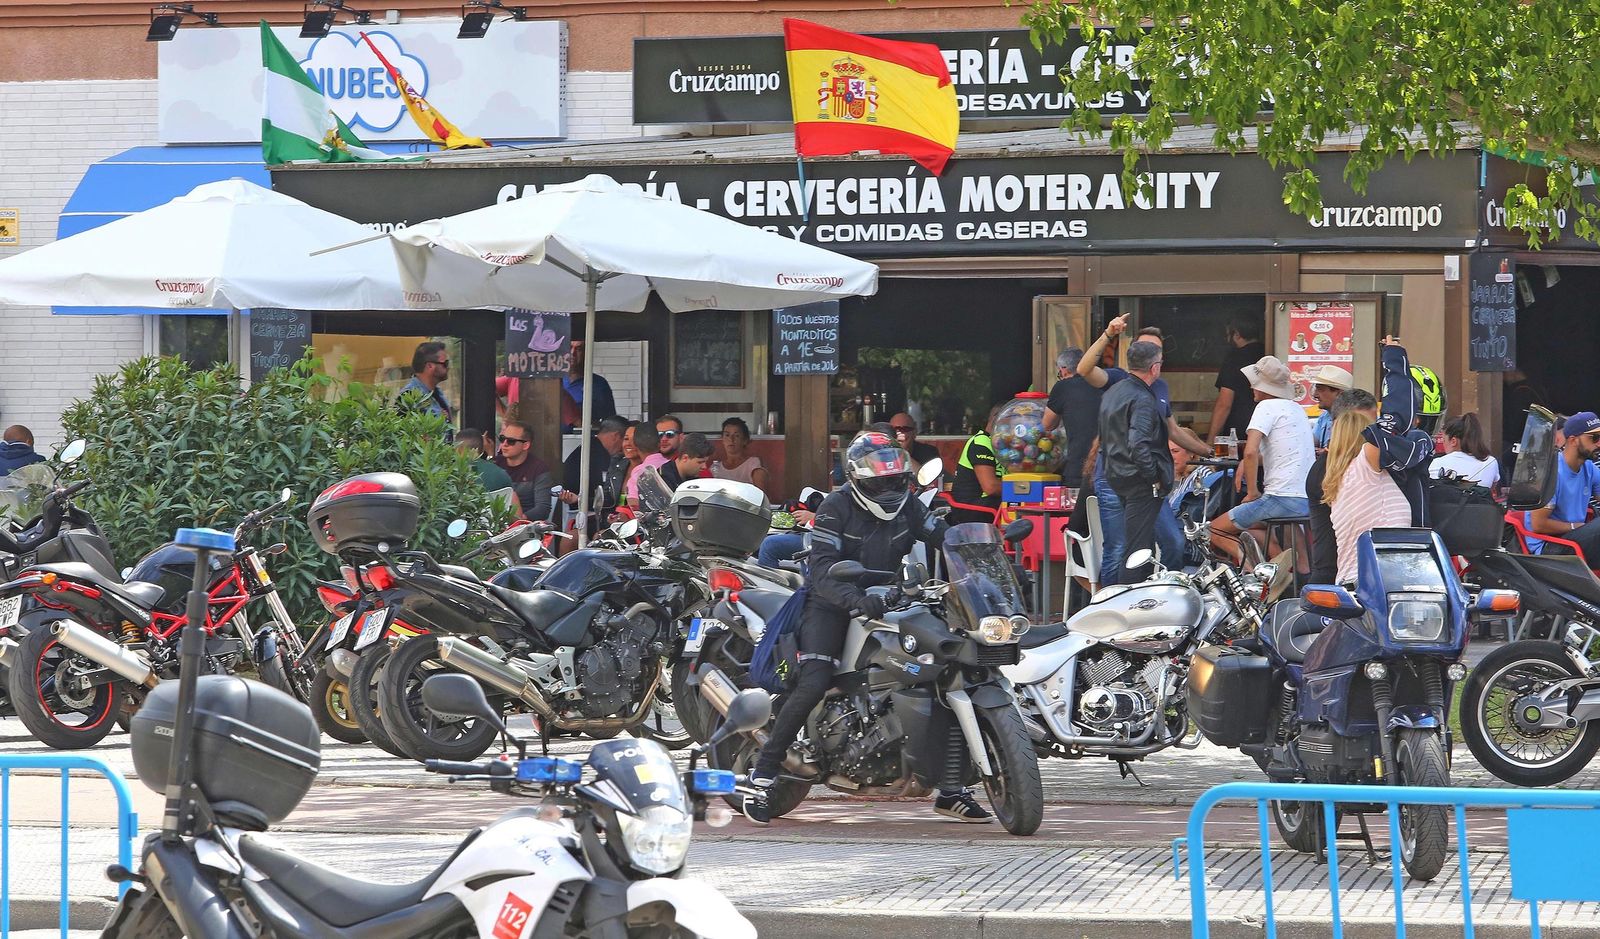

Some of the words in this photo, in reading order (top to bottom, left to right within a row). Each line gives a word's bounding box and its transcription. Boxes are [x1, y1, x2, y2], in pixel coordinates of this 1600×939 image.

[306, 67, 401, 99] NUBES
[669, 69, 780, 94] Cruzcampo
[723, 166, 946, 218] CERVECERÍA
[959, 173, 1125, 213] MOTERA
[816, 222, 943, 242] COMIDAS
[956, 219, 1088, 240] CASERAS
[155, 279, 204, 295] Cruzcampo
[777, 273, 844, 287] Cruzcampo
[773, 309, 803, 325] TODOS
[780, 328, 837, 341] MONTADITOS
[780, 345, 790, 356] A
[1471, 336, 1508, 359] TINTO
[508, 351, 571, 374] MOTEROS
[501, 902, 528, 930] 112
